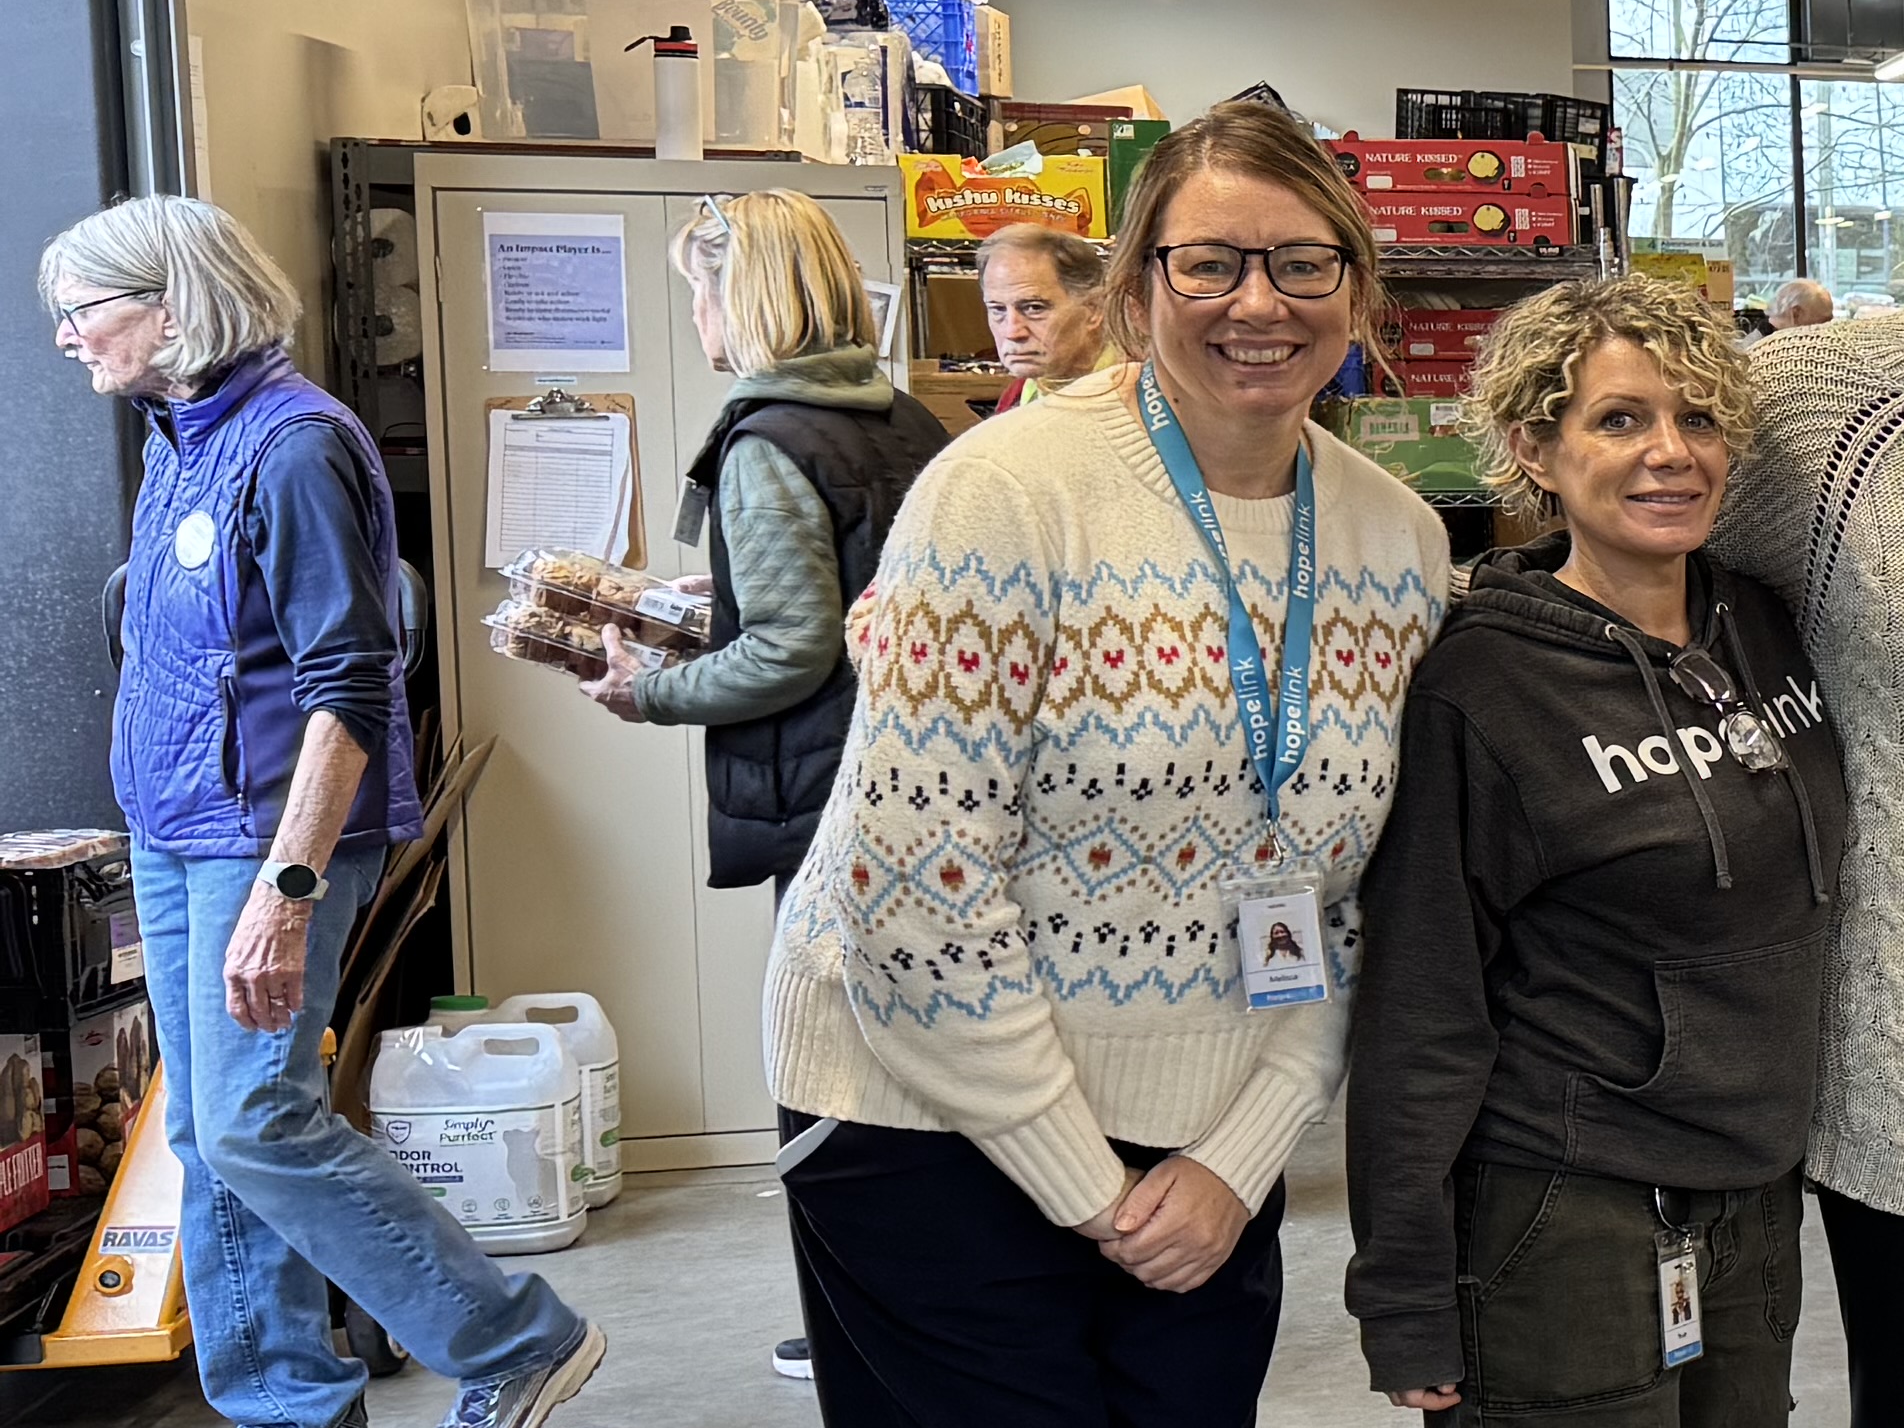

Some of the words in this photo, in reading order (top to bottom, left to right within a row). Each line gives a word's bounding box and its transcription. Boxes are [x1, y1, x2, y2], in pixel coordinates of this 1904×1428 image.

[1365, 153, 1412, 163] NATURE
[927, 188, 999, 213] kishu
[1001, 187, 1081, 215] kisses
[1369, 206, 1416, 216] NATURE
[498, 243, 513, 253] An
[515, 244, 554, 254] Impact
[555, 244, 589, 255] Player
[1292, 503, 1311, 599] hopelink
[1232, 656, 1268, 760] hopelink
[1279, 666, 1303, 765] hopelink
[1581, 675, 1823, 794] hopink
[443, 1118, 495, 1132] Simply
[439, 1130, 498, 1143] Purrfect
[405, 1162, 463, 1173] NTROL
[102, 1231, 174, 1248] RAVAS
